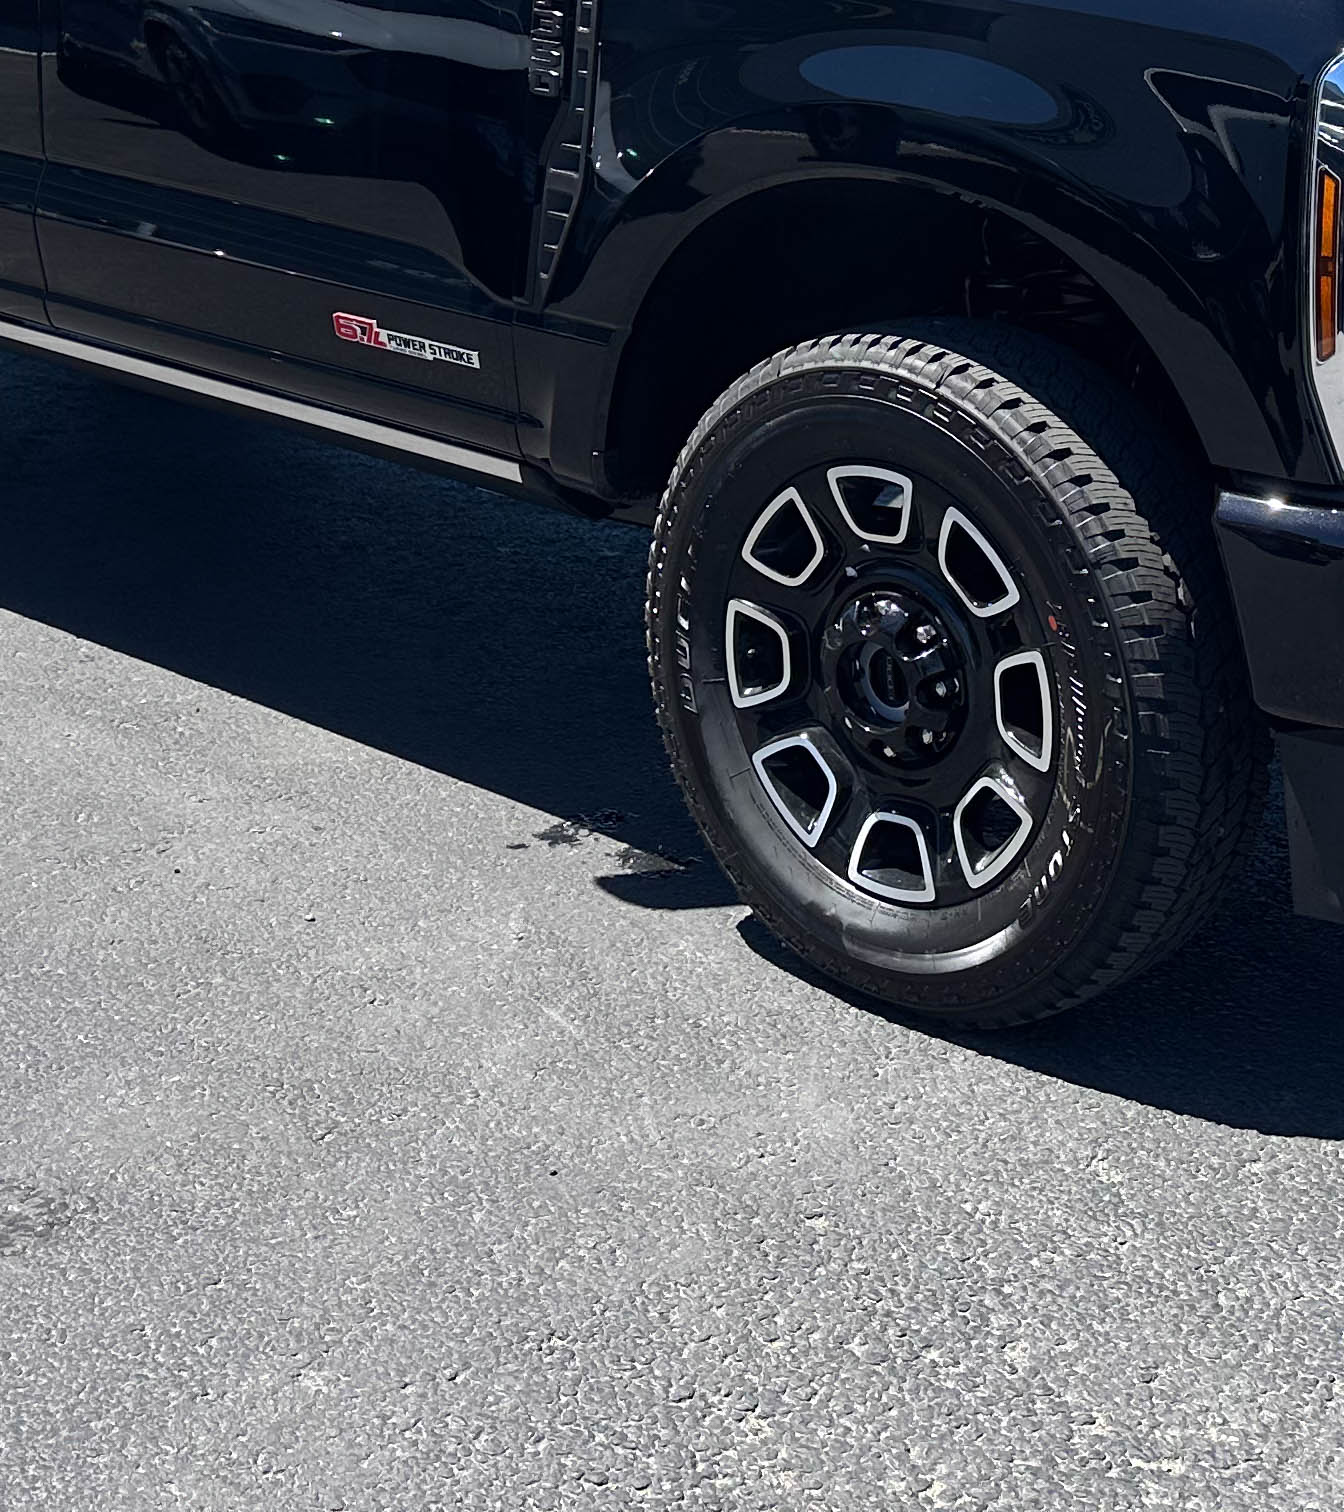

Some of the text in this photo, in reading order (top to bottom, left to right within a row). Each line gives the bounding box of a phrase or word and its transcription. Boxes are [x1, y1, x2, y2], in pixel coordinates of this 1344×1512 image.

[333, 312, 387, 349] 6.7L
[387, 333, 427, 354] POWER
[428, 344, 476, 366] STROKE
